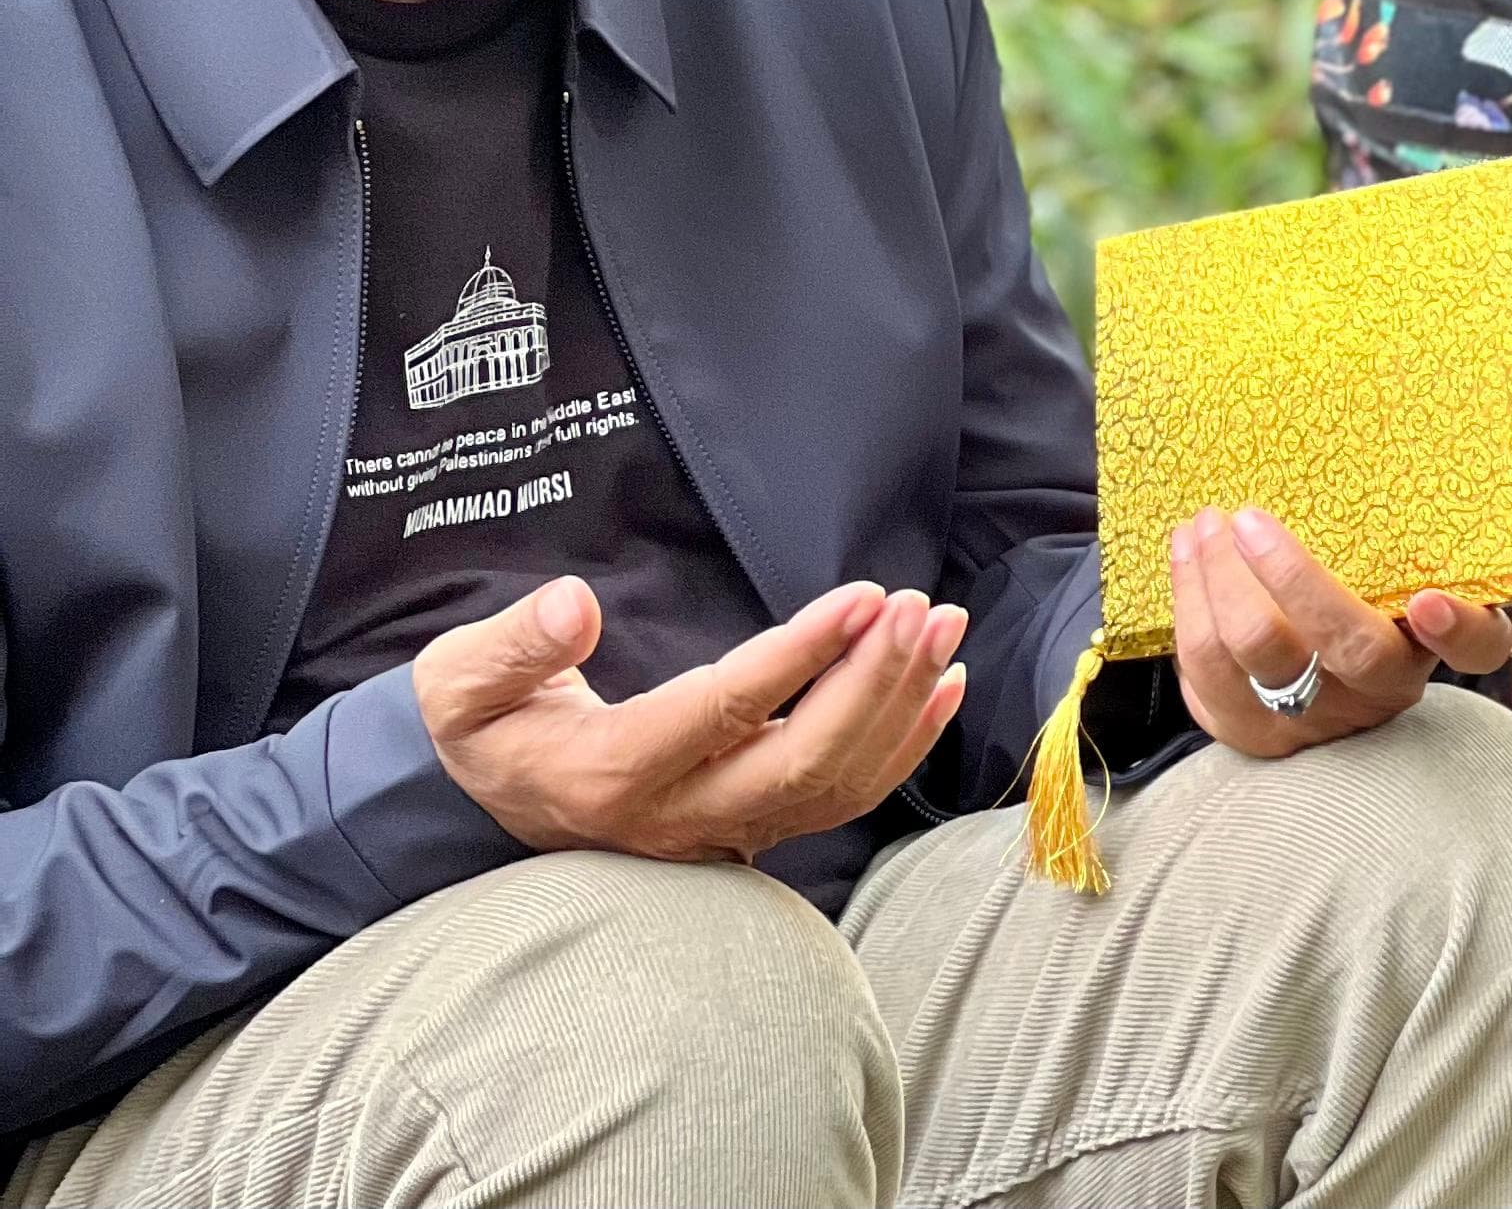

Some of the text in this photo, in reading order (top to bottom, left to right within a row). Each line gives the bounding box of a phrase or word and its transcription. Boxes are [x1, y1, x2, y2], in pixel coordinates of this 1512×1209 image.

[346, 457, 392, 475] There
[455, 428, 506, 451] peace
[512, 422, 526, 439] in
[346, 475, 404, 498] without
[438, 444, 533, 474] Palestinians
[555, 421, 582, 442] full
[586, 411, 639, 436] rights.
[403, 470, 573, 539] MUHAMMAD MURSI
